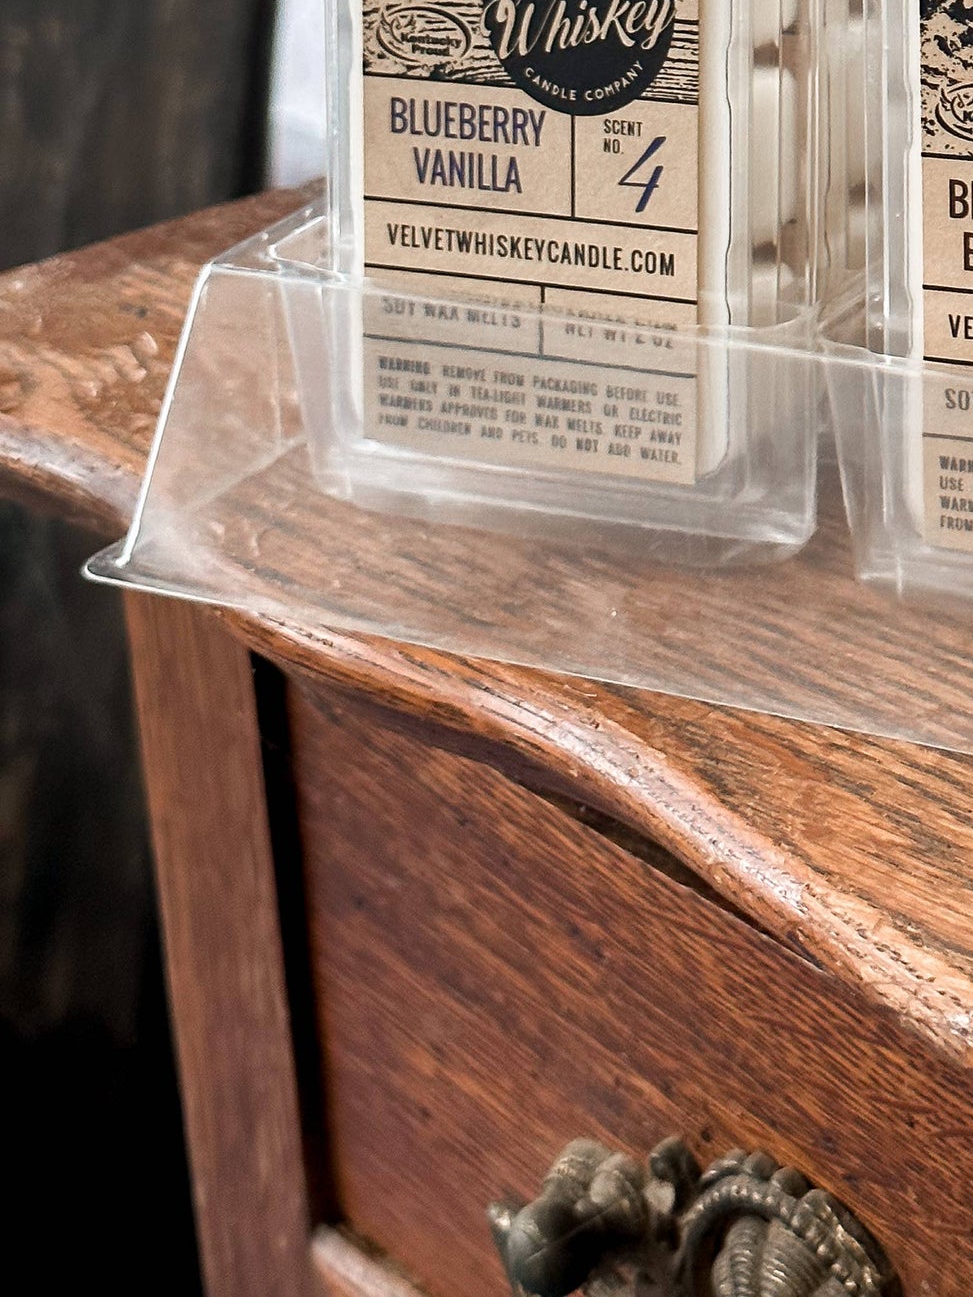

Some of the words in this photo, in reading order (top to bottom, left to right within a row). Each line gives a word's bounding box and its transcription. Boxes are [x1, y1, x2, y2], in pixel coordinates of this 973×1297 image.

[401, 32, 463, 49] Kentucky
[525, 67, 578, 101] CANDLE
[584, 60, 645, 101] COMPANY
[391, 97, 546, 147] BLUEBERRY
[603, 118, 643, 137] SCENT
[603, 138, 624, 154] NO.
[413, 146, 523, 193] VANILLA
[618, 136, 667, 213] 4
[387, 223, 675, 277] VELVETWHISKEYCANDLE.COM
[533, 375, 598, 397] PACKAGING
[605, 384, 648, 402] BEFORE
[536, 395, 592, 414] WARMERS
[629, 406, 682, 426] ELECTRIC
[613, 424, 642, 440] KEEP
[650, 431, 682, 447] AWAY
[939, 476, 964, 491] USE
[940, 515, 973, 532] FROM
